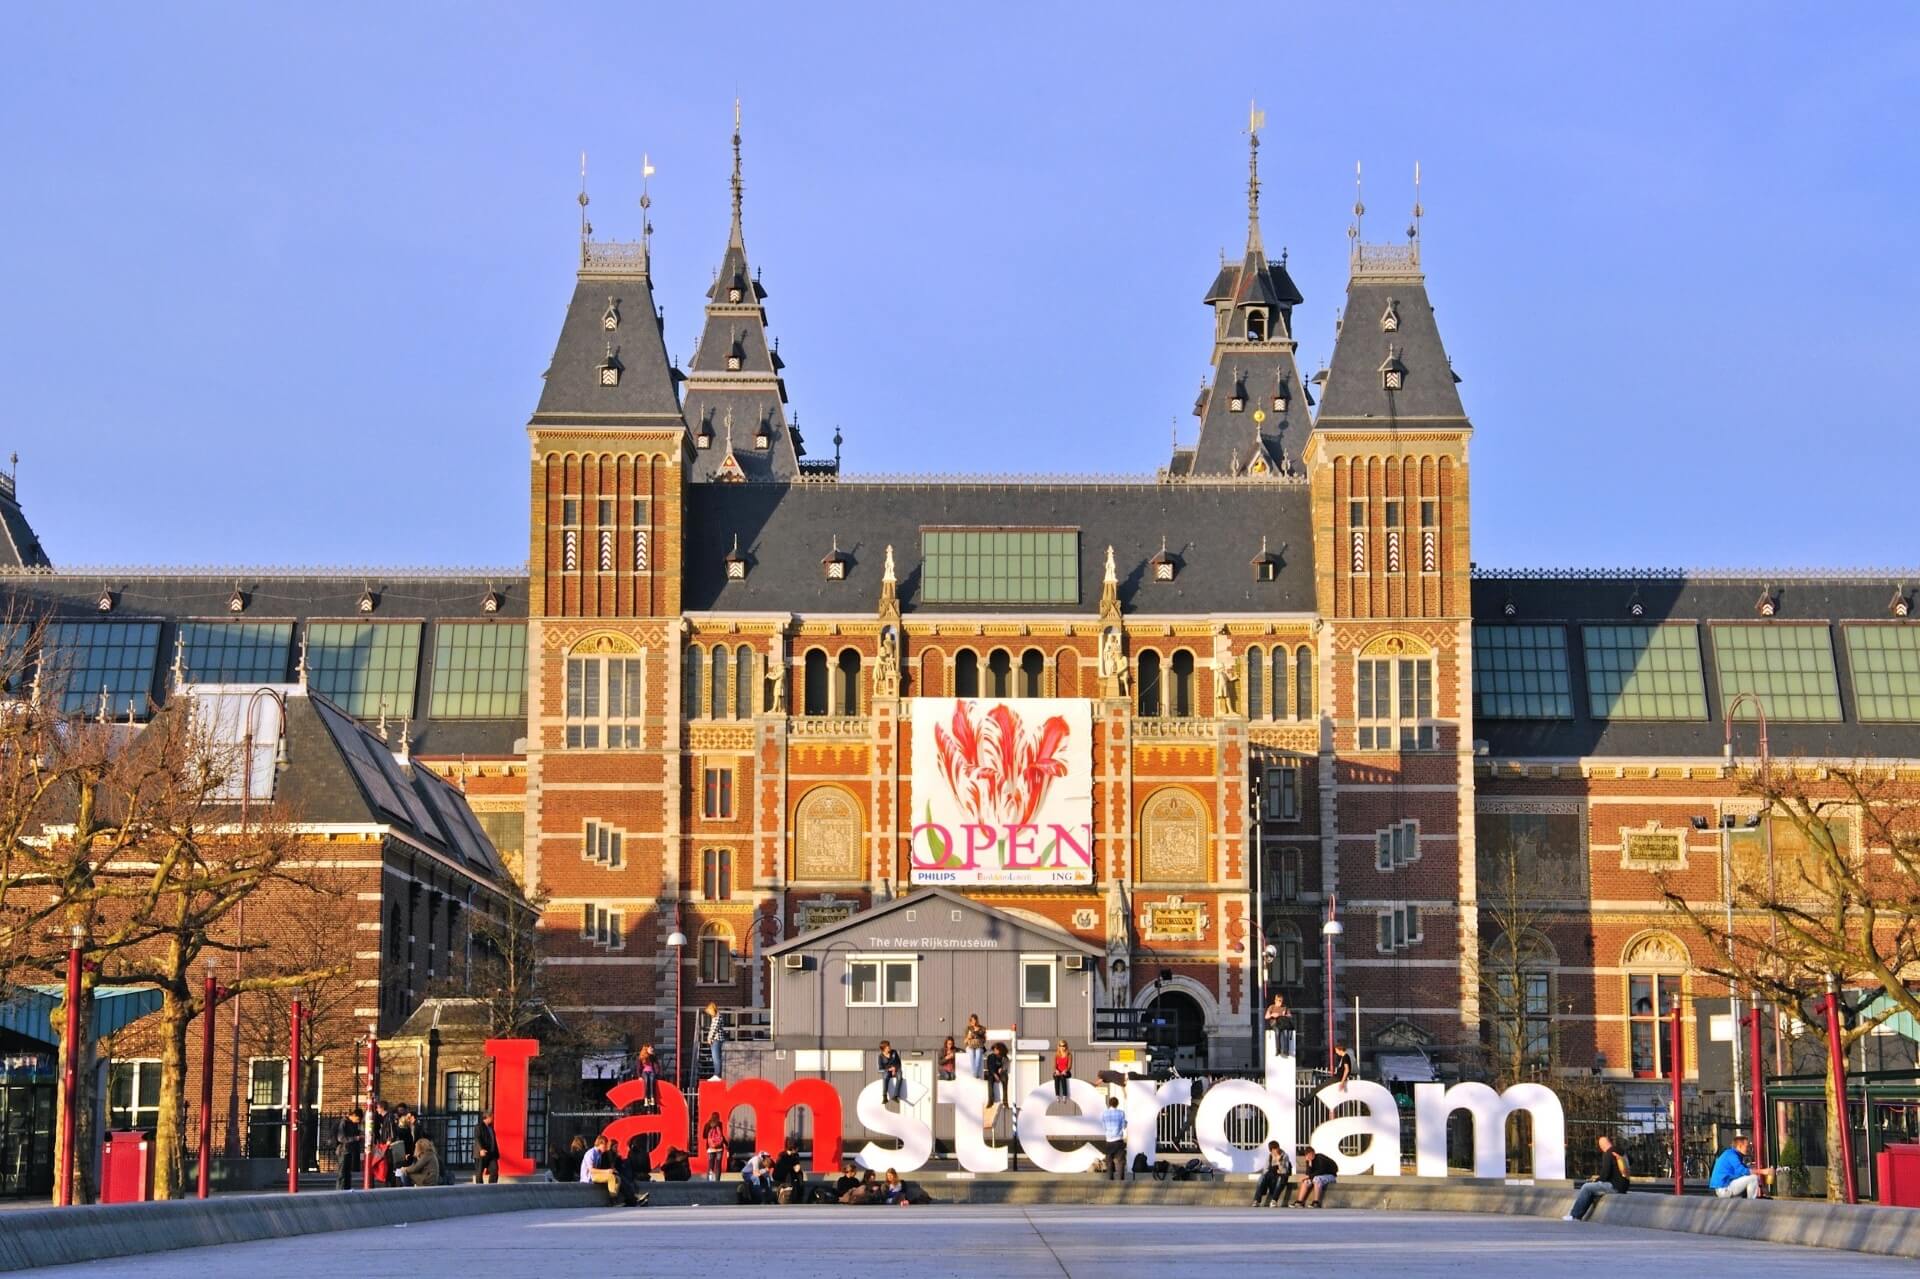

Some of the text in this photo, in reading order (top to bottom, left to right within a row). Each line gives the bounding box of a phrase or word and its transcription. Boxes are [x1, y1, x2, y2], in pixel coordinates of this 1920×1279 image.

[912, 823, 1091, 869] OPEN
[918, 872, 956, 881] PHILIPS
[1052, 872, 1073, 881] ING
[869, 937, 998, 949] The New Rijksmuseum
[484, 1039, 540, 1176] I
